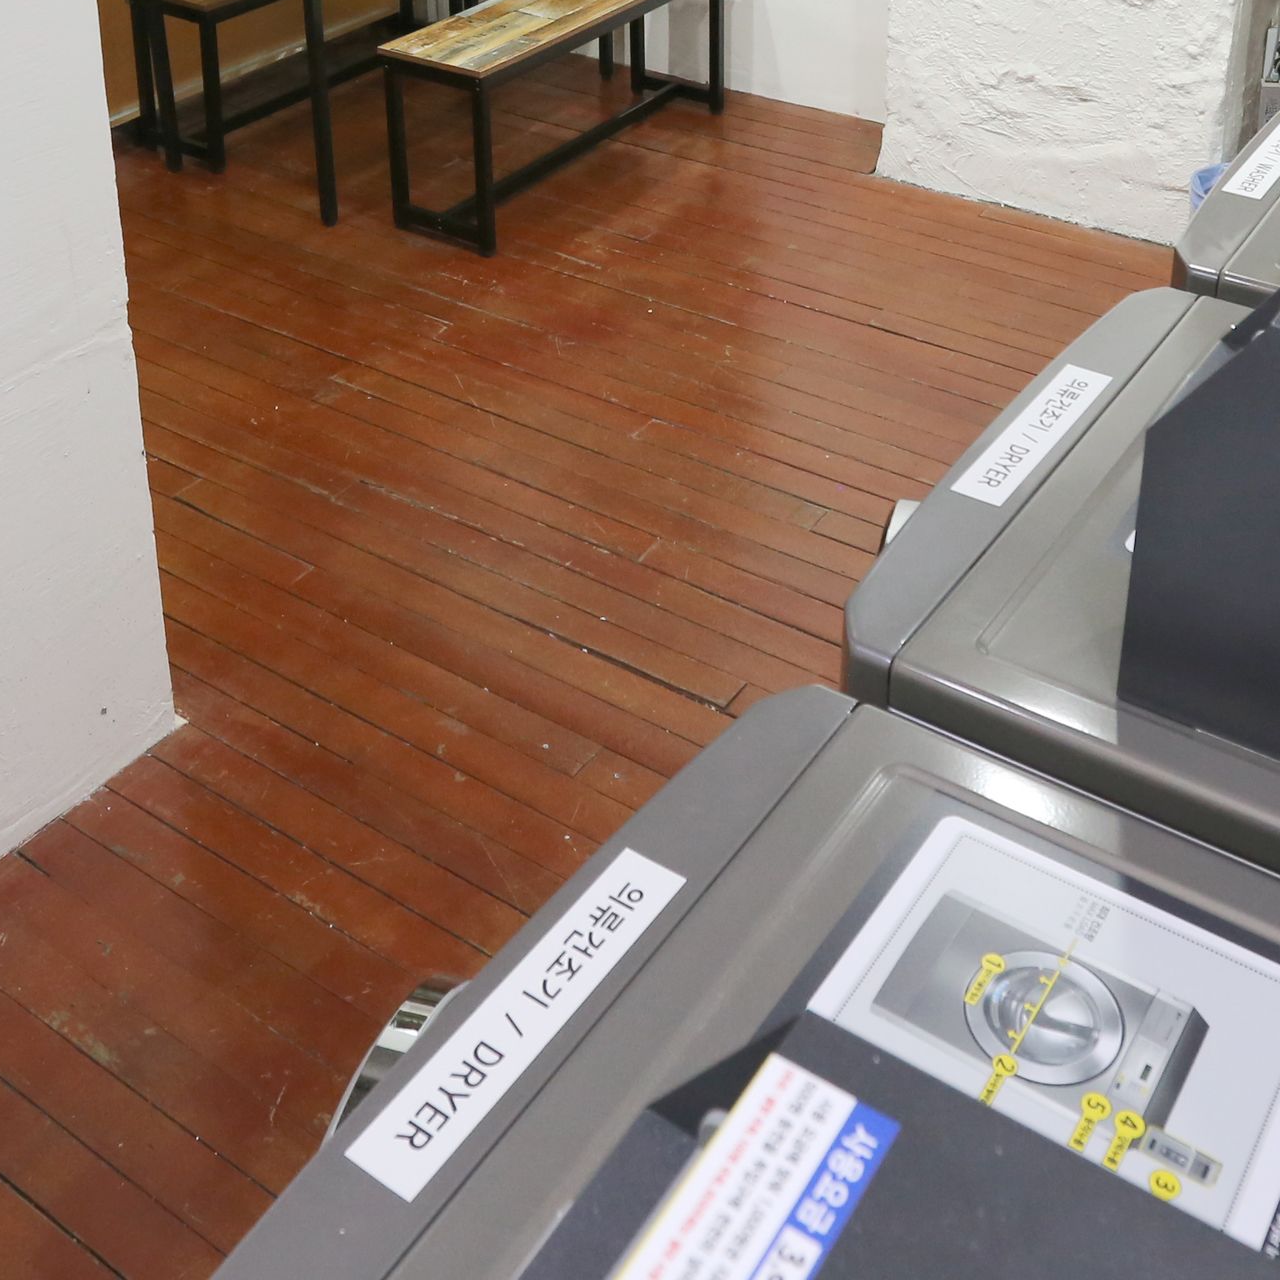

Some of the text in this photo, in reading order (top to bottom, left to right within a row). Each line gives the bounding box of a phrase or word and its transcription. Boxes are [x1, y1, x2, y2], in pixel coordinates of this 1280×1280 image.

[1029, 379, 1088, 432] 의류건조기
[977, 444, 1030, 488] DRYER
[523, 882, 643, 1008] 의류건조기
[396, 1041, 505, 1150] DRYER
[1087, 1099, 1106, 1114] 5
[1119, 1115, 1138, 1131] 4
[795, 1123, 878, 1235] 사용요금
[1156, 1178, 1175, 1194] 3
